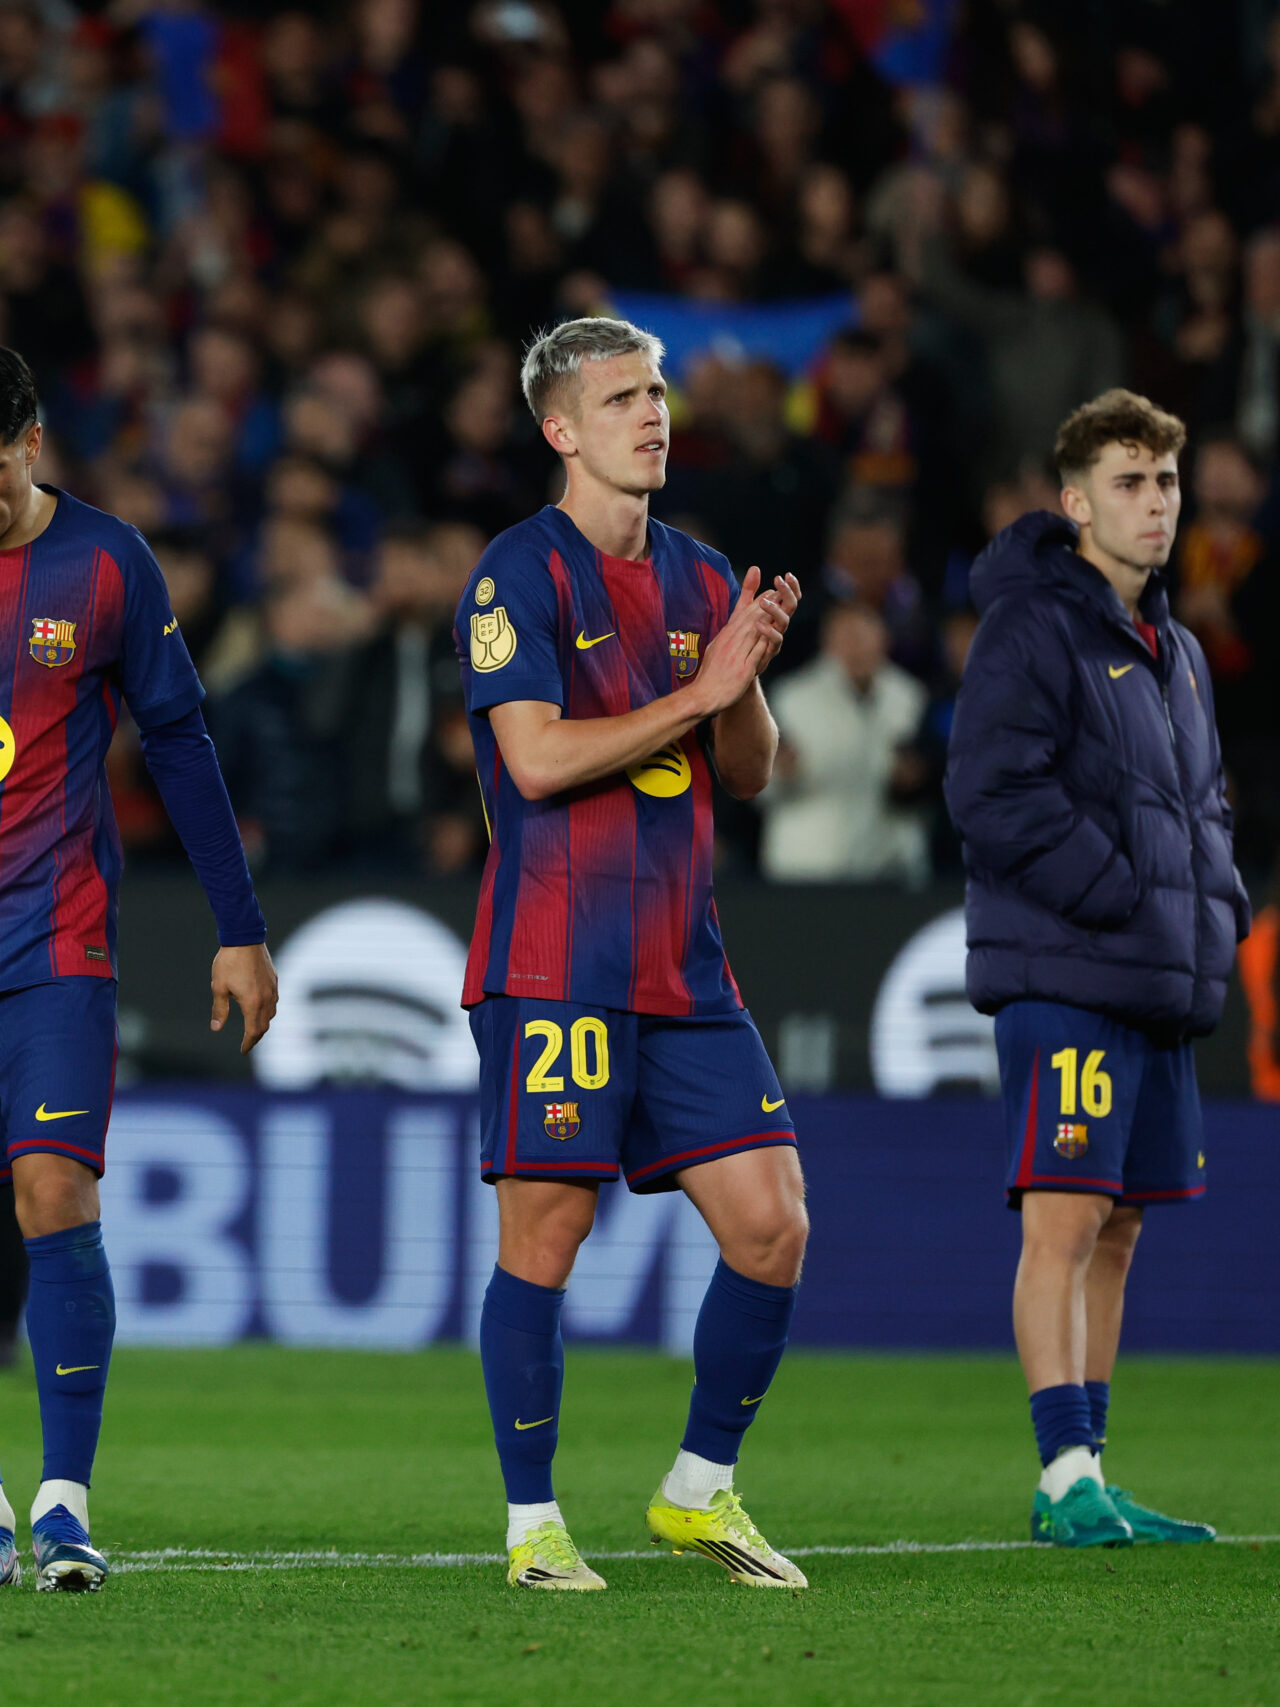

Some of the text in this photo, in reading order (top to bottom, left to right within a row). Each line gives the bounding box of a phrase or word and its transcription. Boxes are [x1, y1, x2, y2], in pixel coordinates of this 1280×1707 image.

[479, 586, 489, 597] 32
[524, 1016, 610, 1093] 20
[1051, 1047, 1113, 1118] 16
